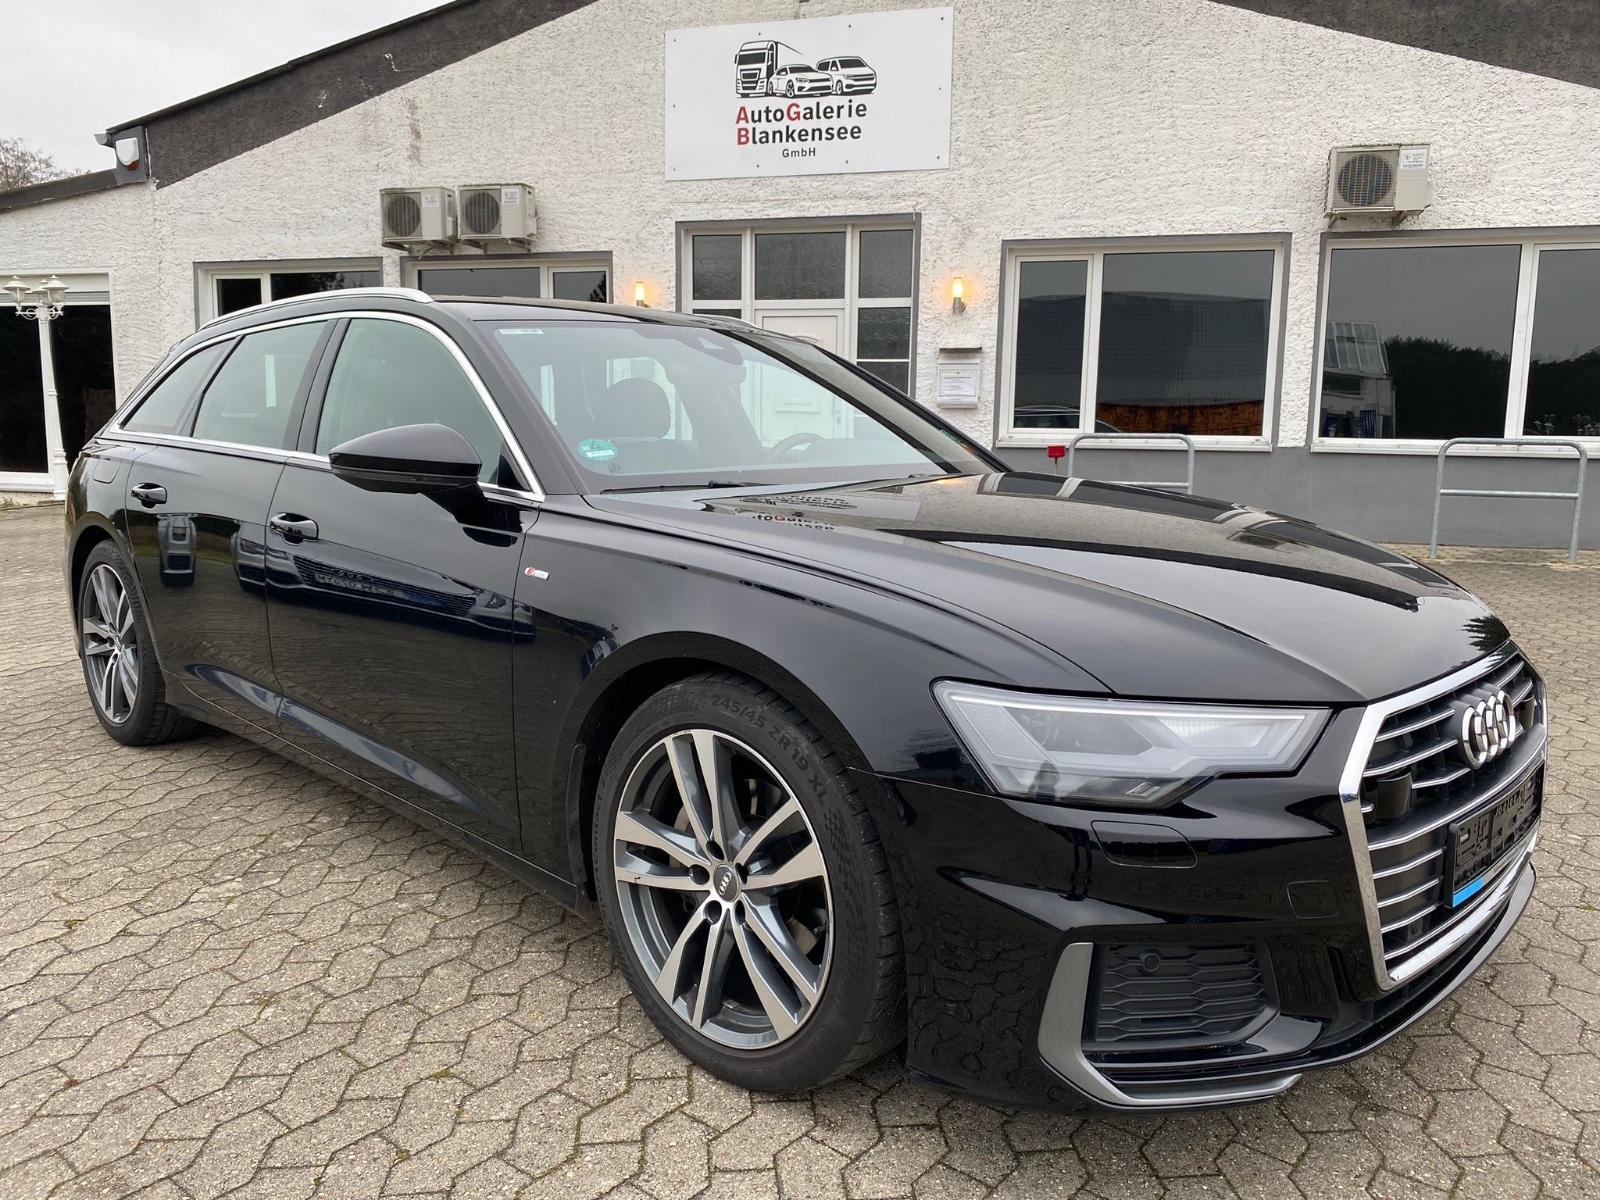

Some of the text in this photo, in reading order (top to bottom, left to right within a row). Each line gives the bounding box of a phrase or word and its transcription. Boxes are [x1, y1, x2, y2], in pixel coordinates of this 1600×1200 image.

[736, 99, 867, 124] AutoGalerie
[737, 125, 862, 145] Blankensee
[782, 147, 816, 158] GmbH
